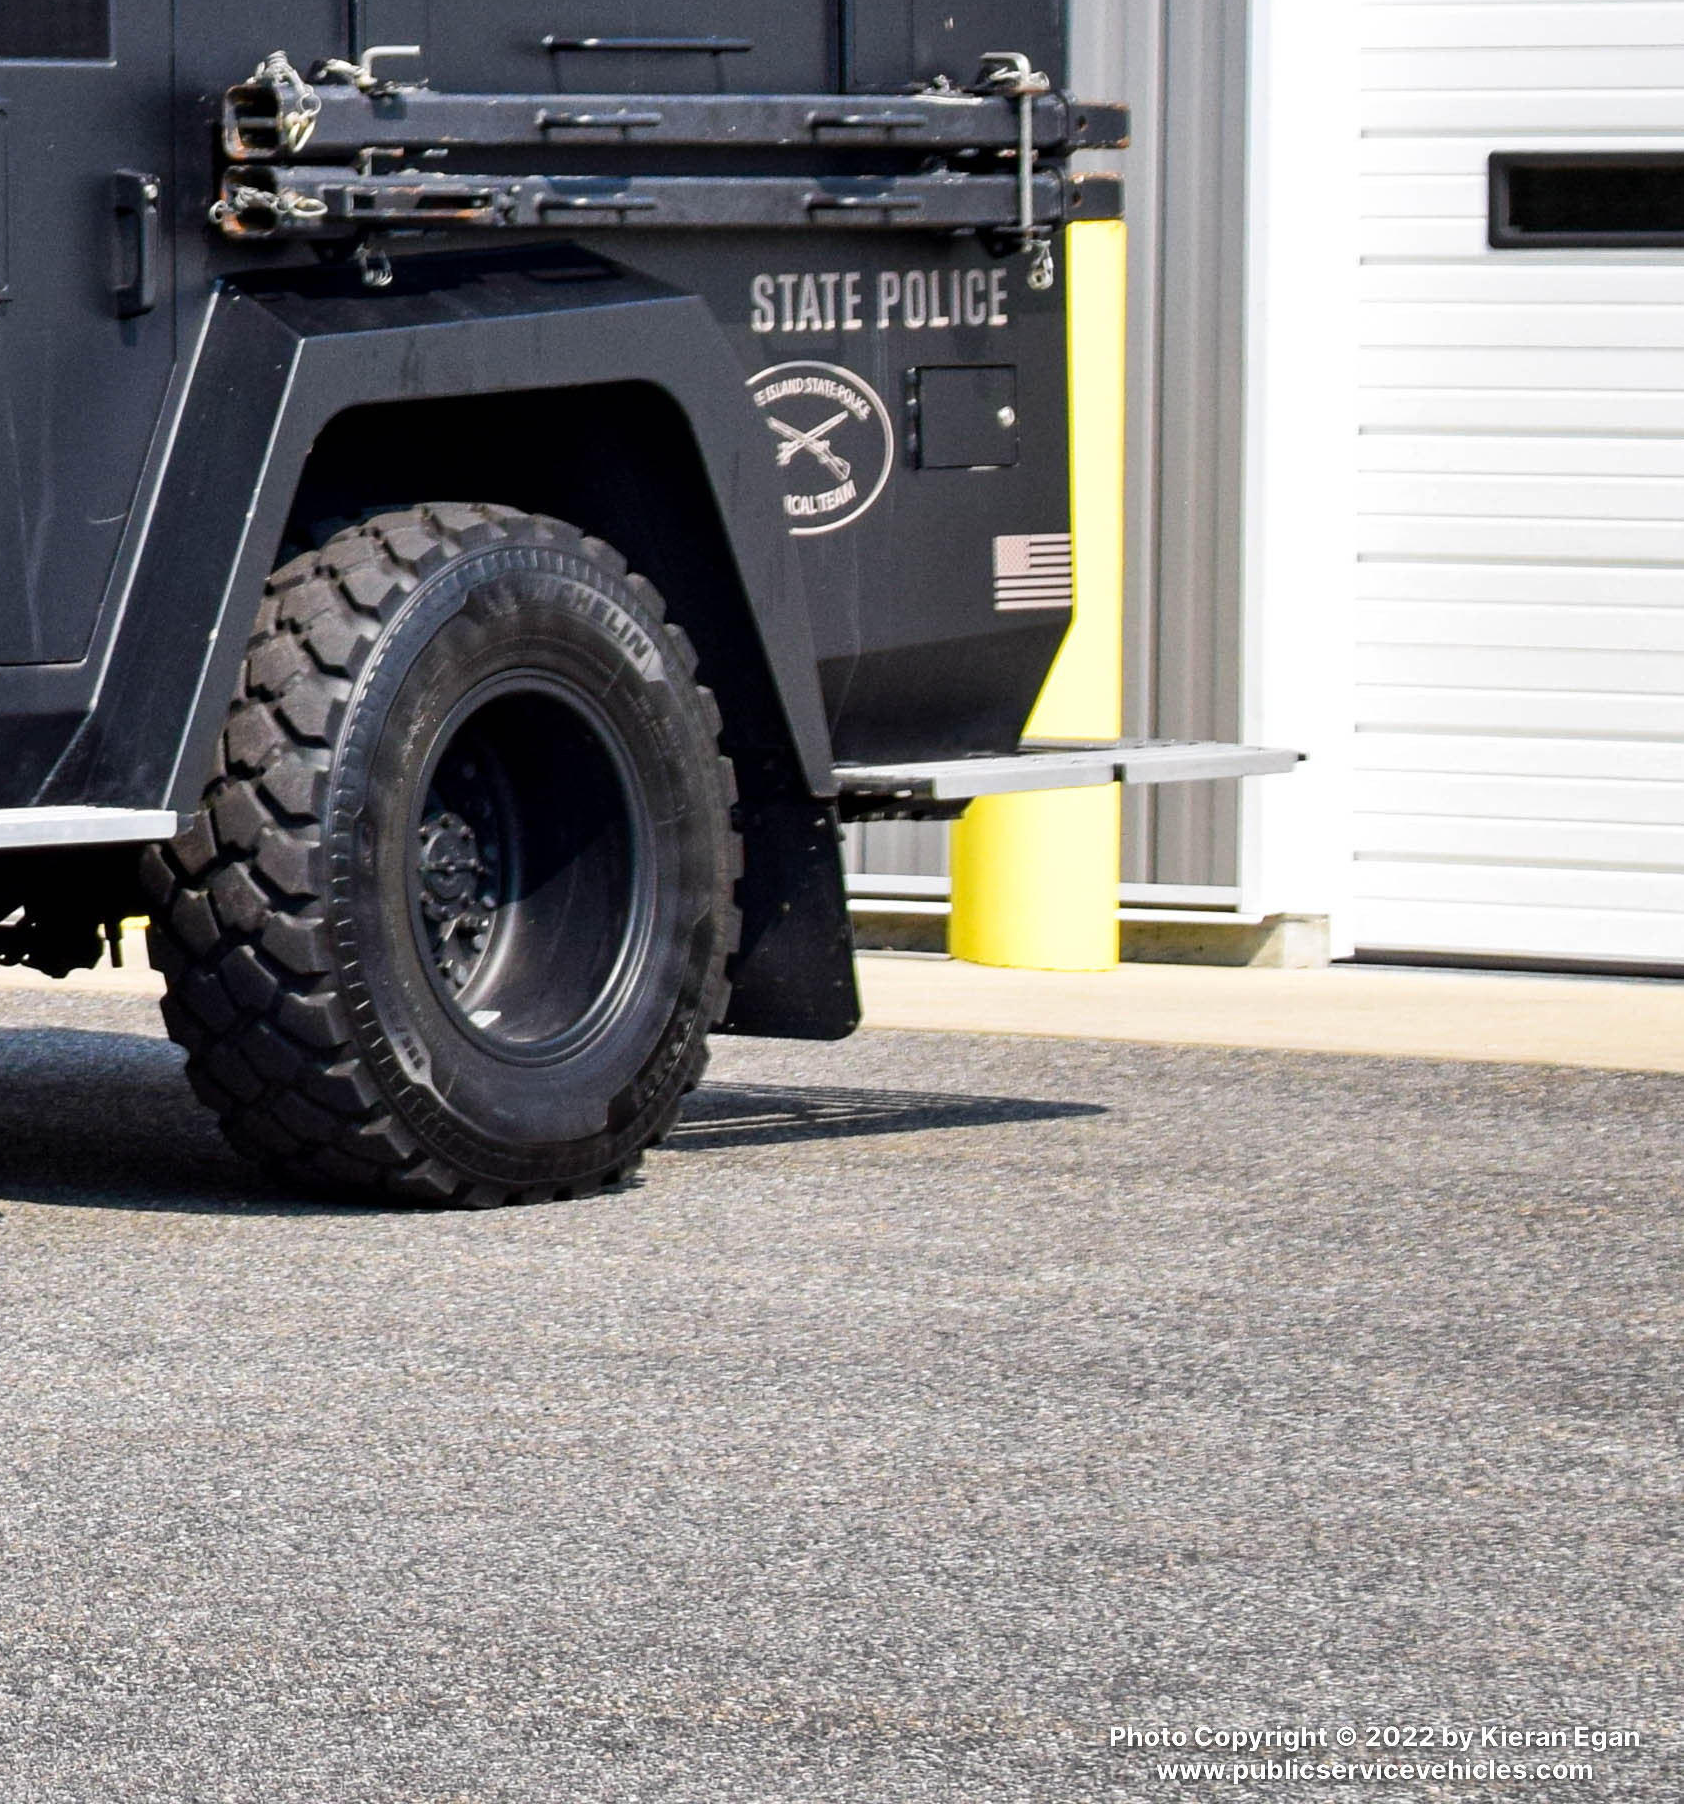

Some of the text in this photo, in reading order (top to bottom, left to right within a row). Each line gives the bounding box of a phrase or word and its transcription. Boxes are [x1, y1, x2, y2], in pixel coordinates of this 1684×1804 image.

[751, 268, 1008, 332] STATE POLICE
[766, 377, 803, 402] ISLAND
[802, 376, 838, 399] STATE
[837, 383, 872, 422] POLICE
[815, 479, 857, 513] TEAM
